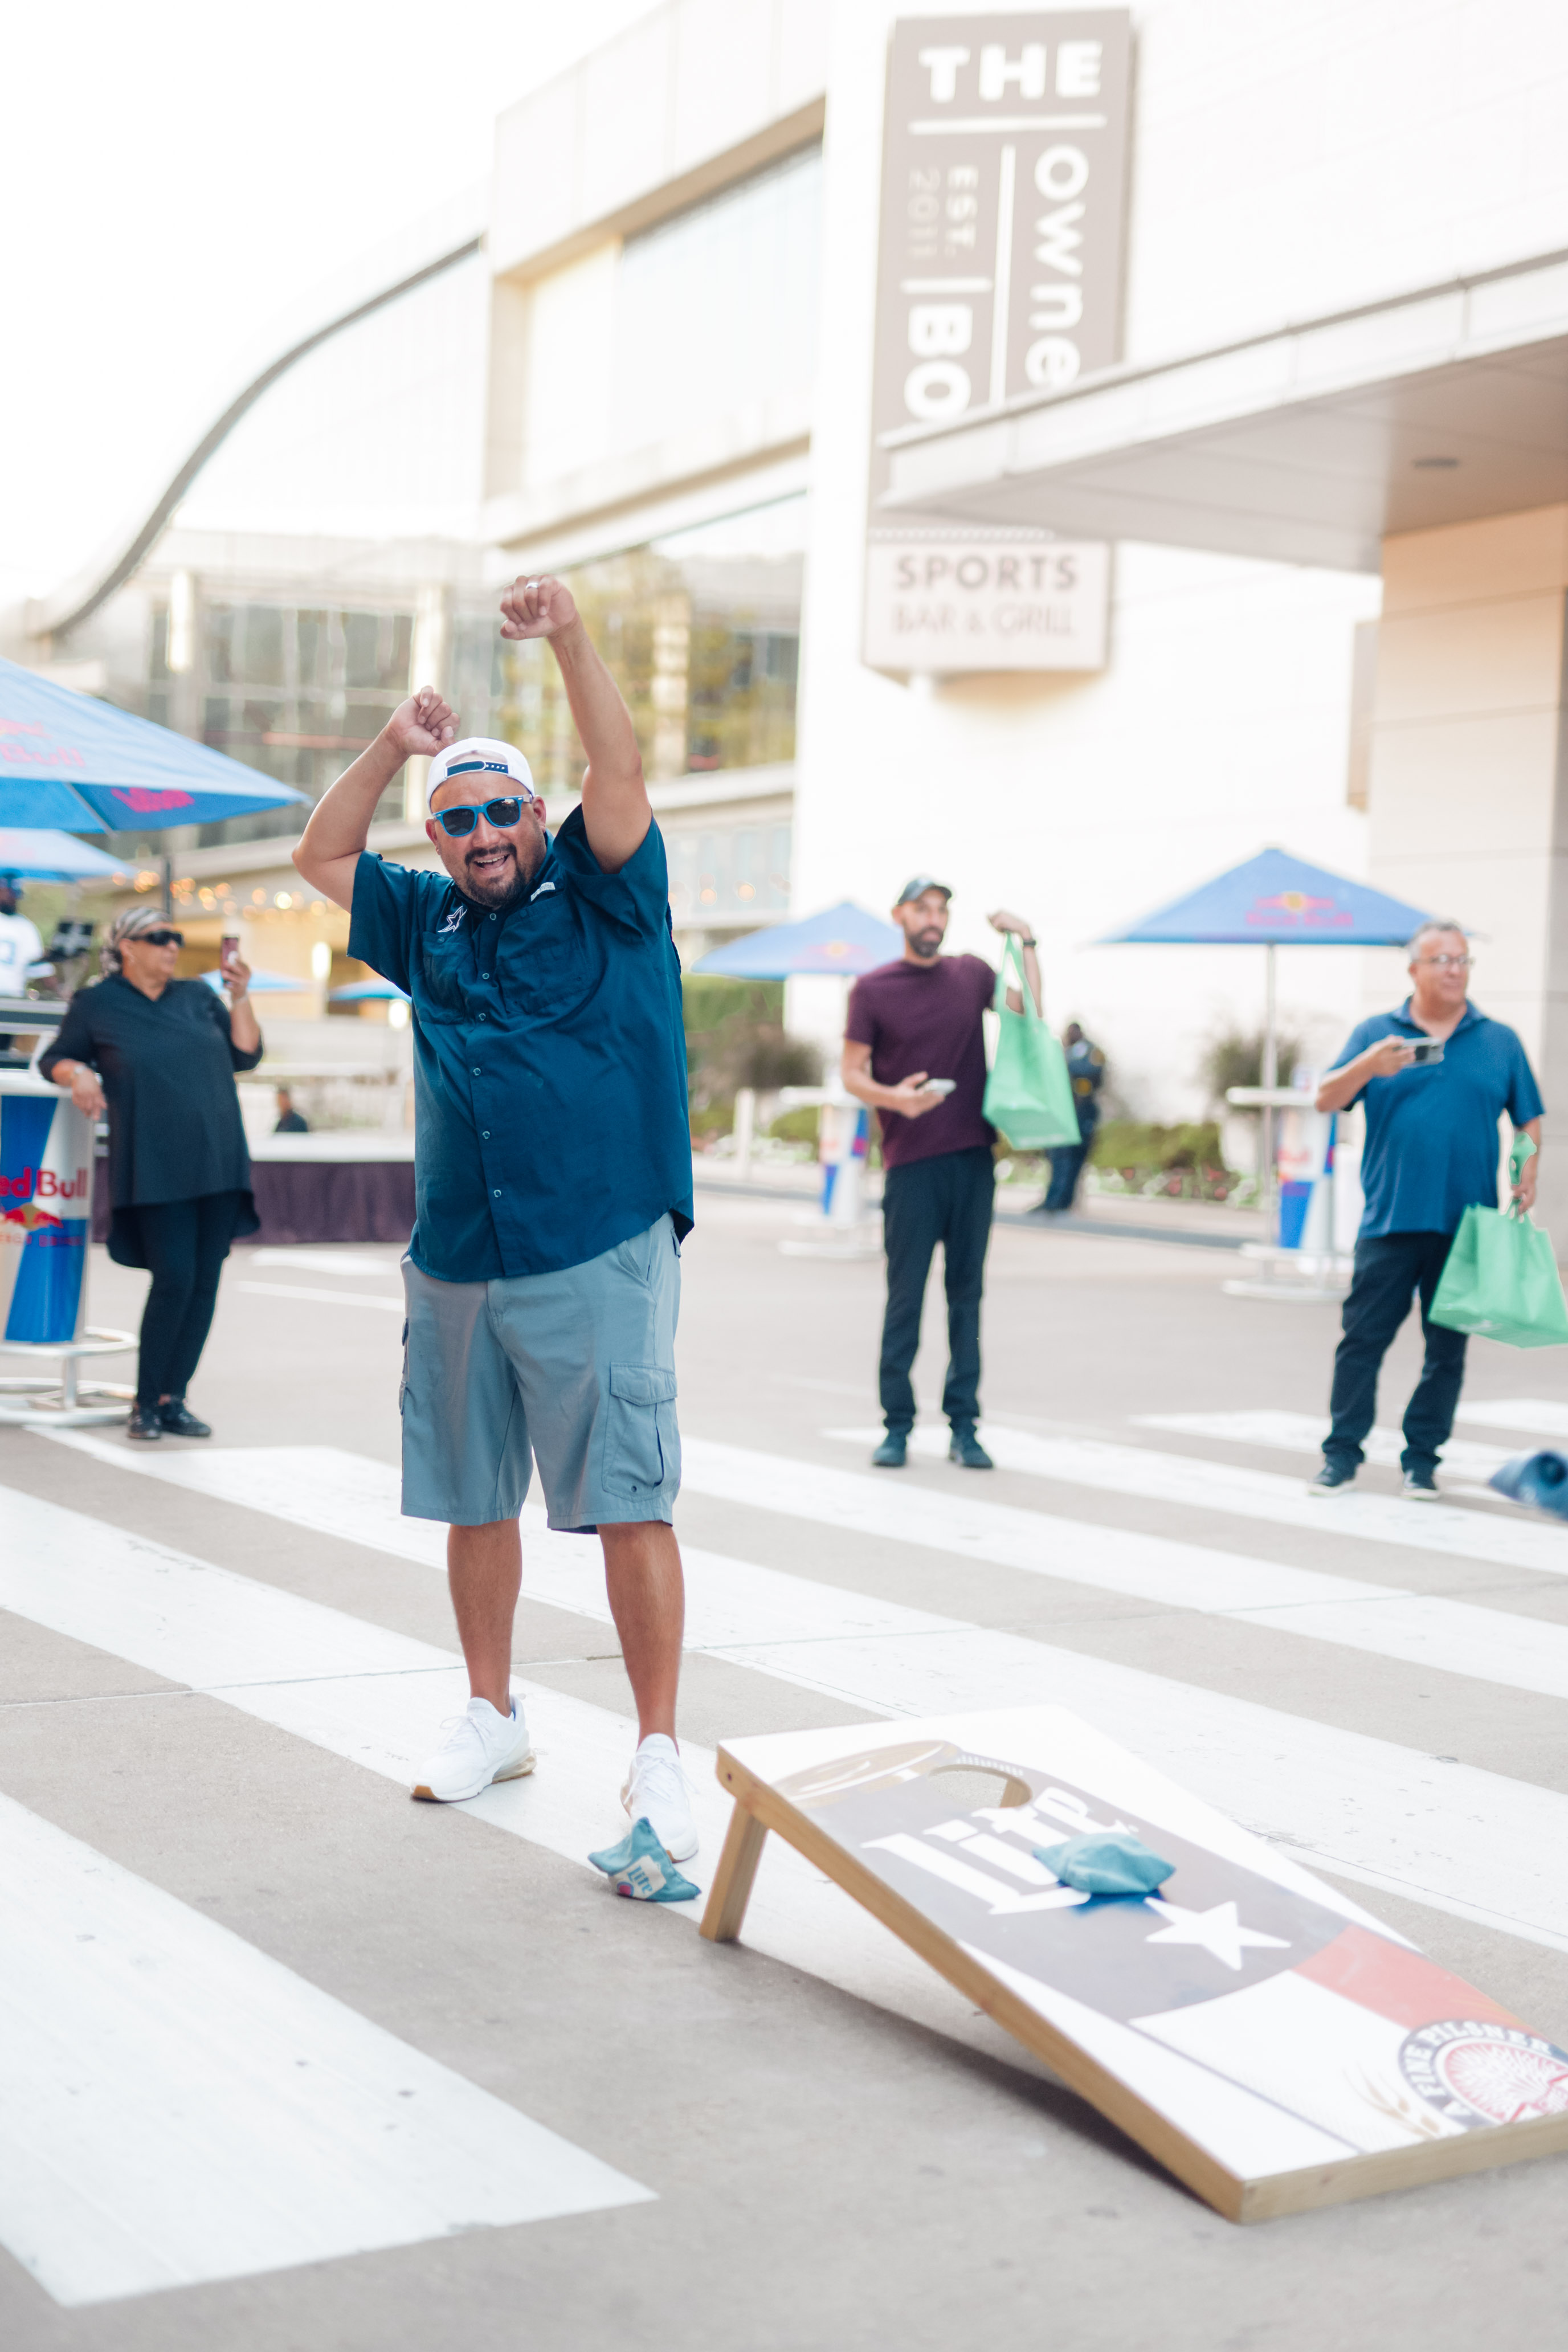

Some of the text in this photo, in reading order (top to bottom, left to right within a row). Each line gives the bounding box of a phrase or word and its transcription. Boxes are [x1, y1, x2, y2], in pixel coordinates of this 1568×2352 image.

[917, 40, 1103, 103] THE
[907, 165, 941, 260] 2011
[944, 165, 979, 259] EST.
[896, 554, 1079, 591] SPORTS
[893, 602, 1077, 636] BAR & GRILL
[36, 1168, 88, 1199] Bull
[1416, 2020, 1553, 2056] PILSNER
[1403, 2043, 1447, 2097] FINE
